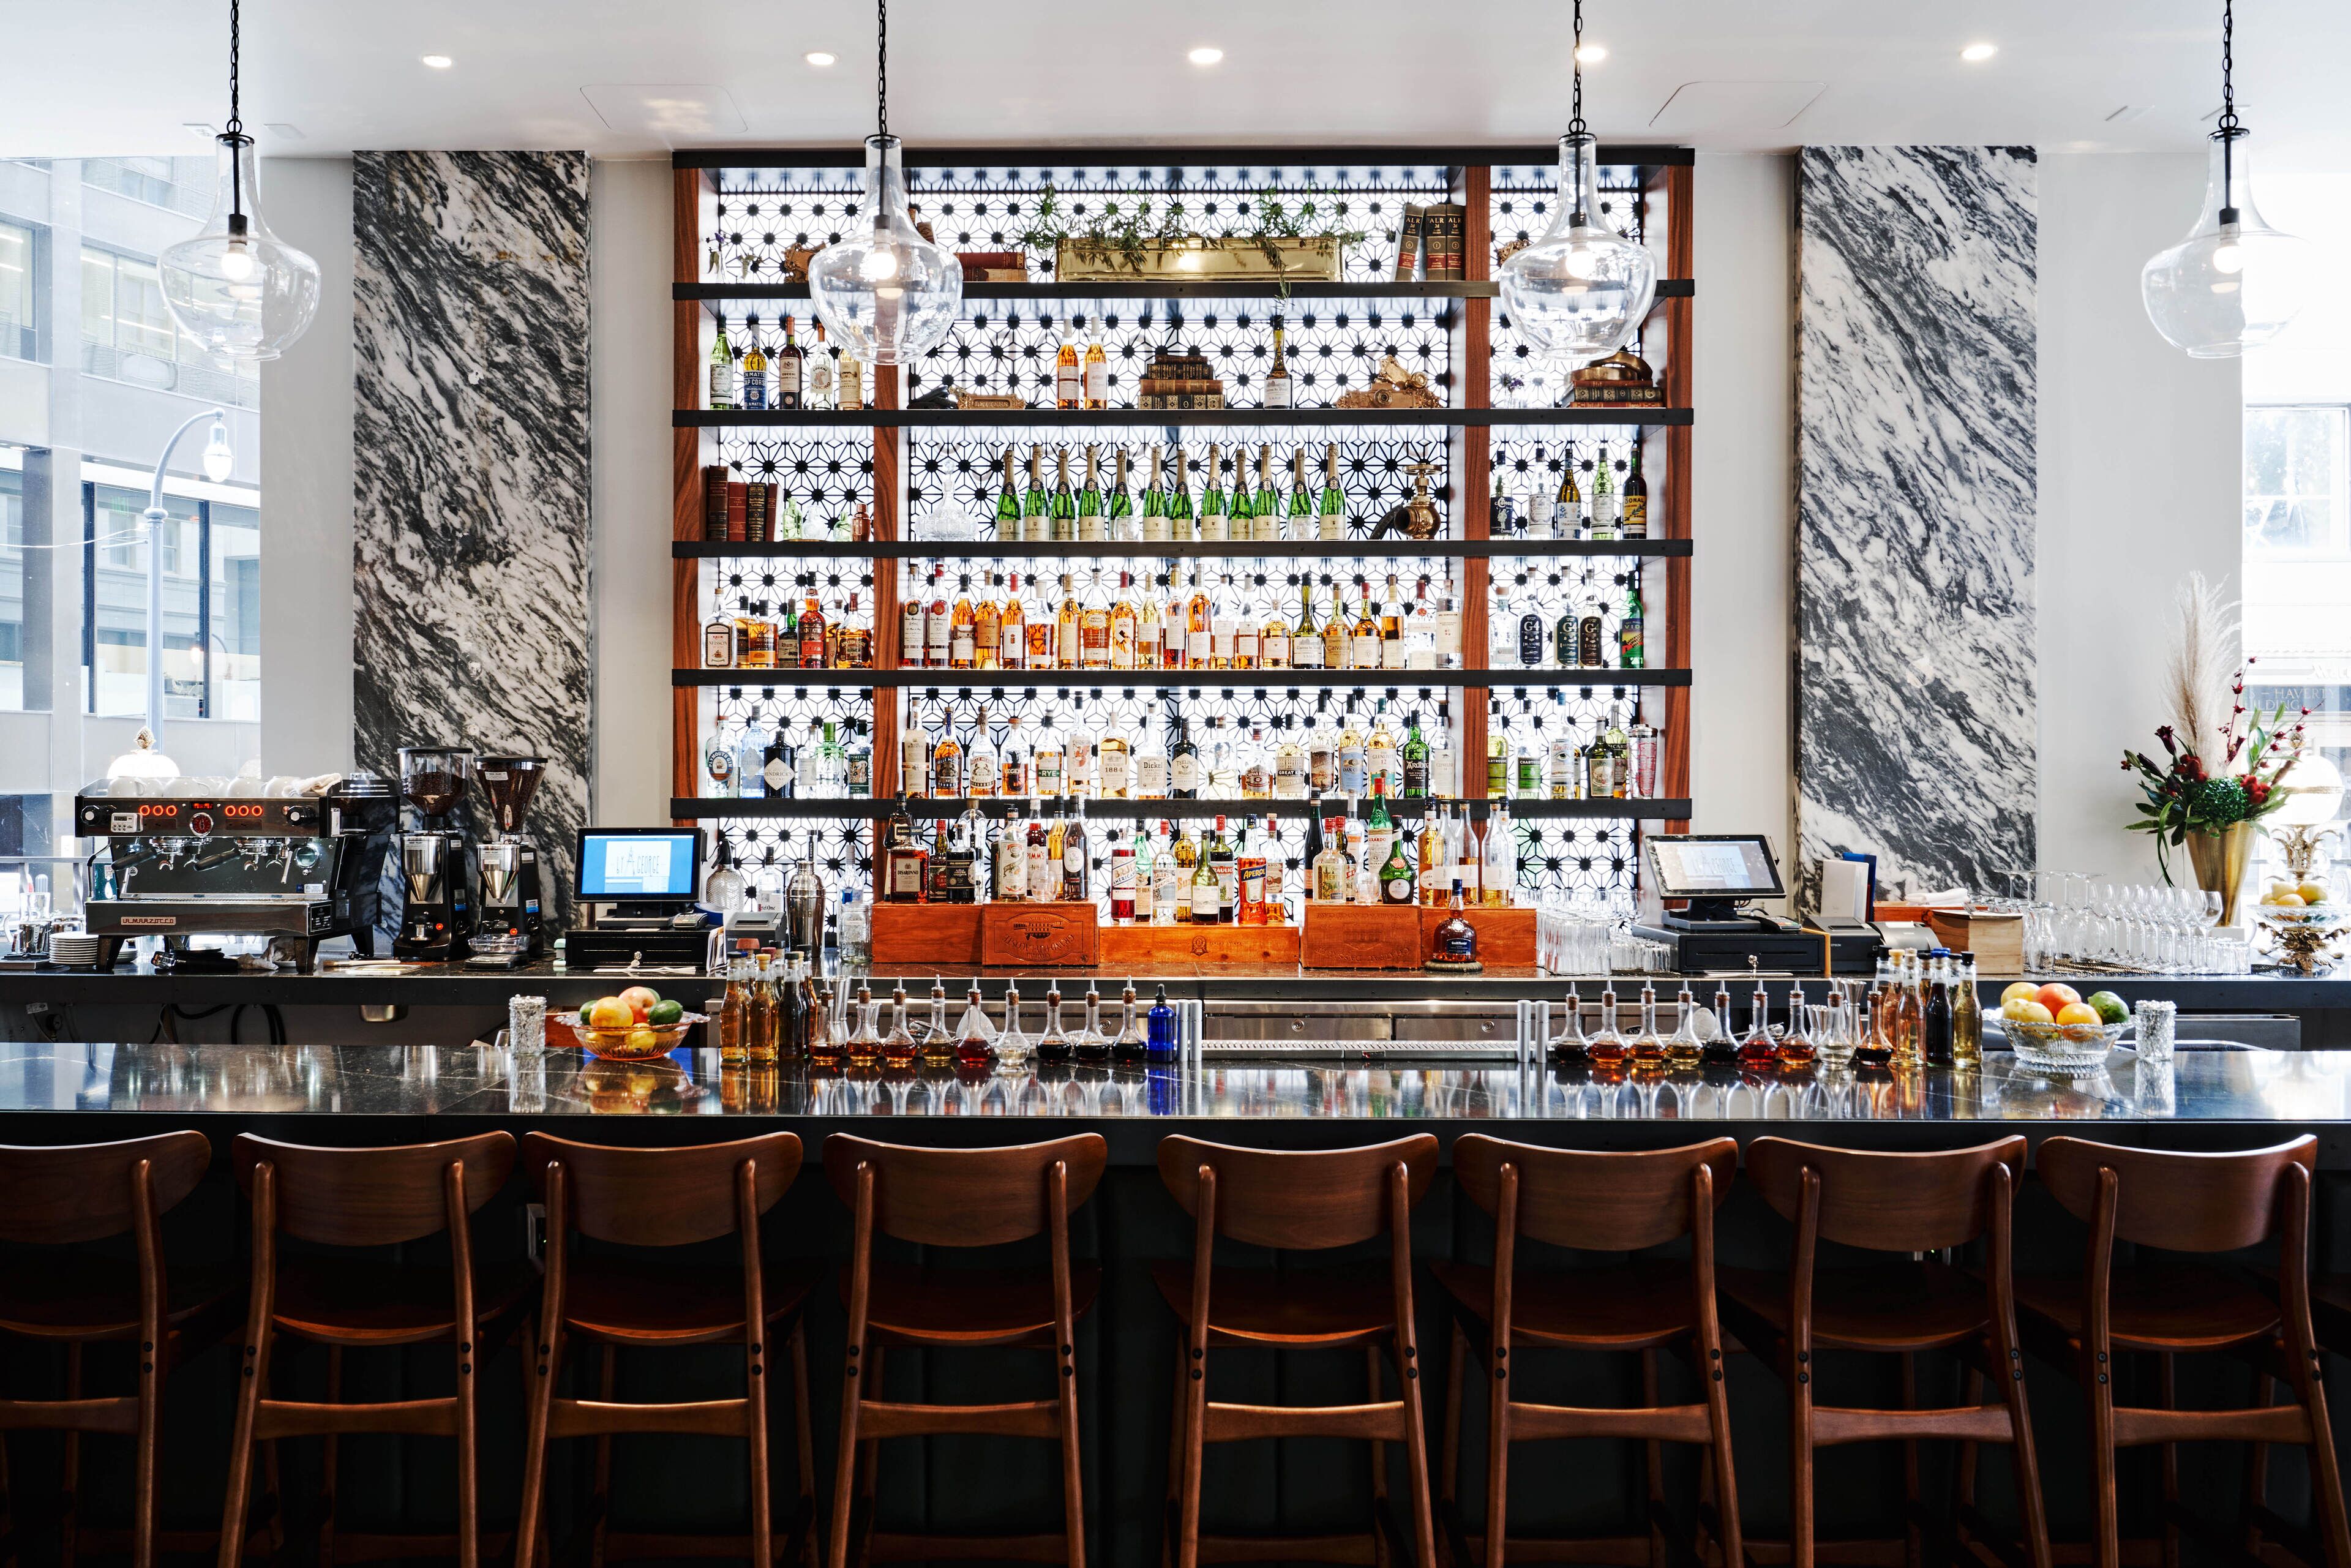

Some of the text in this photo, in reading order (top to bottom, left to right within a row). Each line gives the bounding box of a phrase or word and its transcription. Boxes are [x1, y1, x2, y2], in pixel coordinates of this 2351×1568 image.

[1523, 621, 1540, 631] G4
[1562, 622, 1578, 632] G4
[2274, 688, 2336, 699] HAVERTY
[709, 751, 728, 767] PLYMOUTH
[1243, 868, 1265, 879] APEROL
